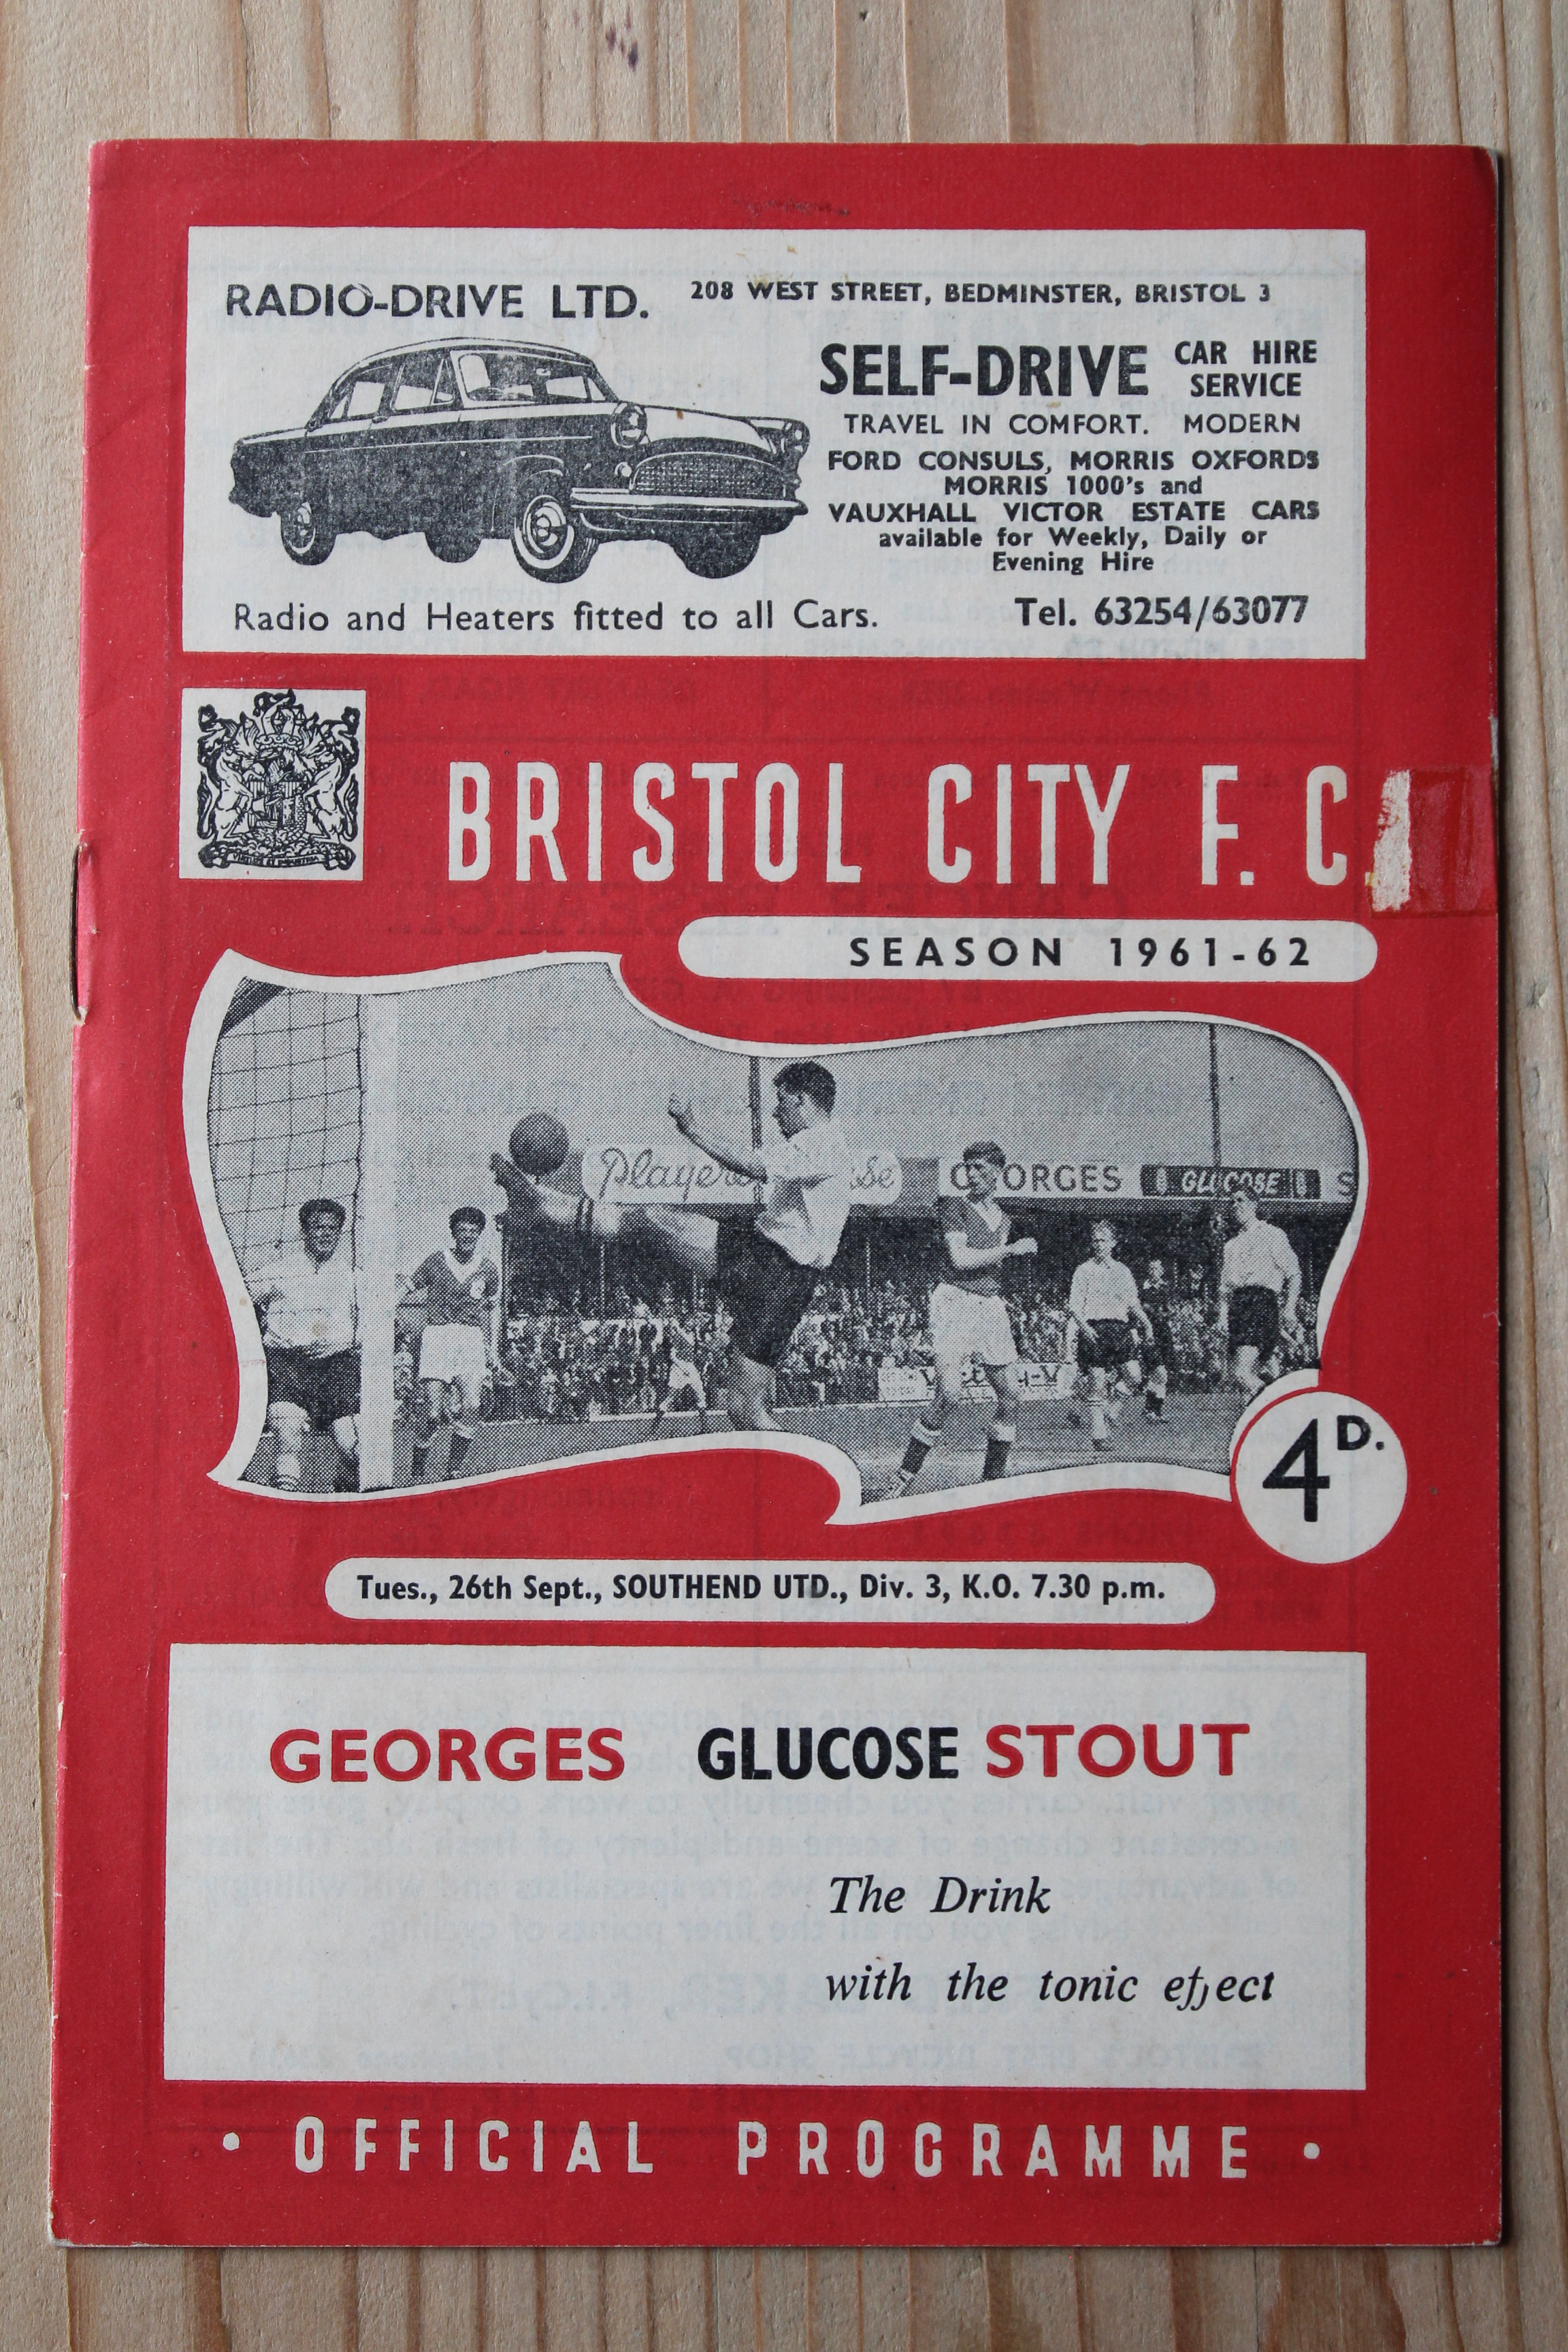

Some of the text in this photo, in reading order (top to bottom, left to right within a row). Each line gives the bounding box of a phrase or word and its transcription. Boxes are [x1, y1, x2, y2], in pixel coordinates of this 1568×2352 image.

[227, 283, 649, 318] RADIO-DRIVE LTD.
[691, 280, 1271, 307] 208 WEST STREET, BEDMINSTER, BRISTOL 3
[1175, 340, 1318, 365] CAR HIRE
[820, 343, 1149, 397] SELF-DRIVE
[1190, 372, 1301, 397] SERVICE
[844, 413, 1300, 435] TRAVEL IN COMFORT. MODERN
[828, 449, 1320, 477] FORD CONSULS, MORRIS OXFORDS
[945, 474, 1203, 496] MORRIS 1000's and
[828, 500, 1320, 523] VAUXHALL VICTOR ESTATE CARS
[879, 525, 1268, 551] available for Weekly, Daily or
[992, 552, 1155, 576] Evening Hire
[235, 598, 878, 632] Radio and Heaters fitted to all Cars.
[1014, 595, 1309, 632] Tel. 63254/63077
[448, 761, 862, 884] BRISTOL
[927, 764, 1130, 885] CITY
[850, 936, 1310, 967] SEASON 1961-62
[950, 1162, 1122, 1194] GORGES
[357, 1573, 1165, 1607] Tues., 26th Sept., SOUTHEND UTD., Div. 3, K.O. 7.30 p.m.
[270, 1723, 1250, 1784] GEORGES GLUCOSE STOUT
[830, 1874, 1051, 1914] The Drink
[826, 1961, 911, 2001] with
[947, 1962, 1009, 2002] the
[1039, 1965, 1139, 2002] tonic
[295, 2116, 1247, 2178] OFFICIAL PROGRAMME
